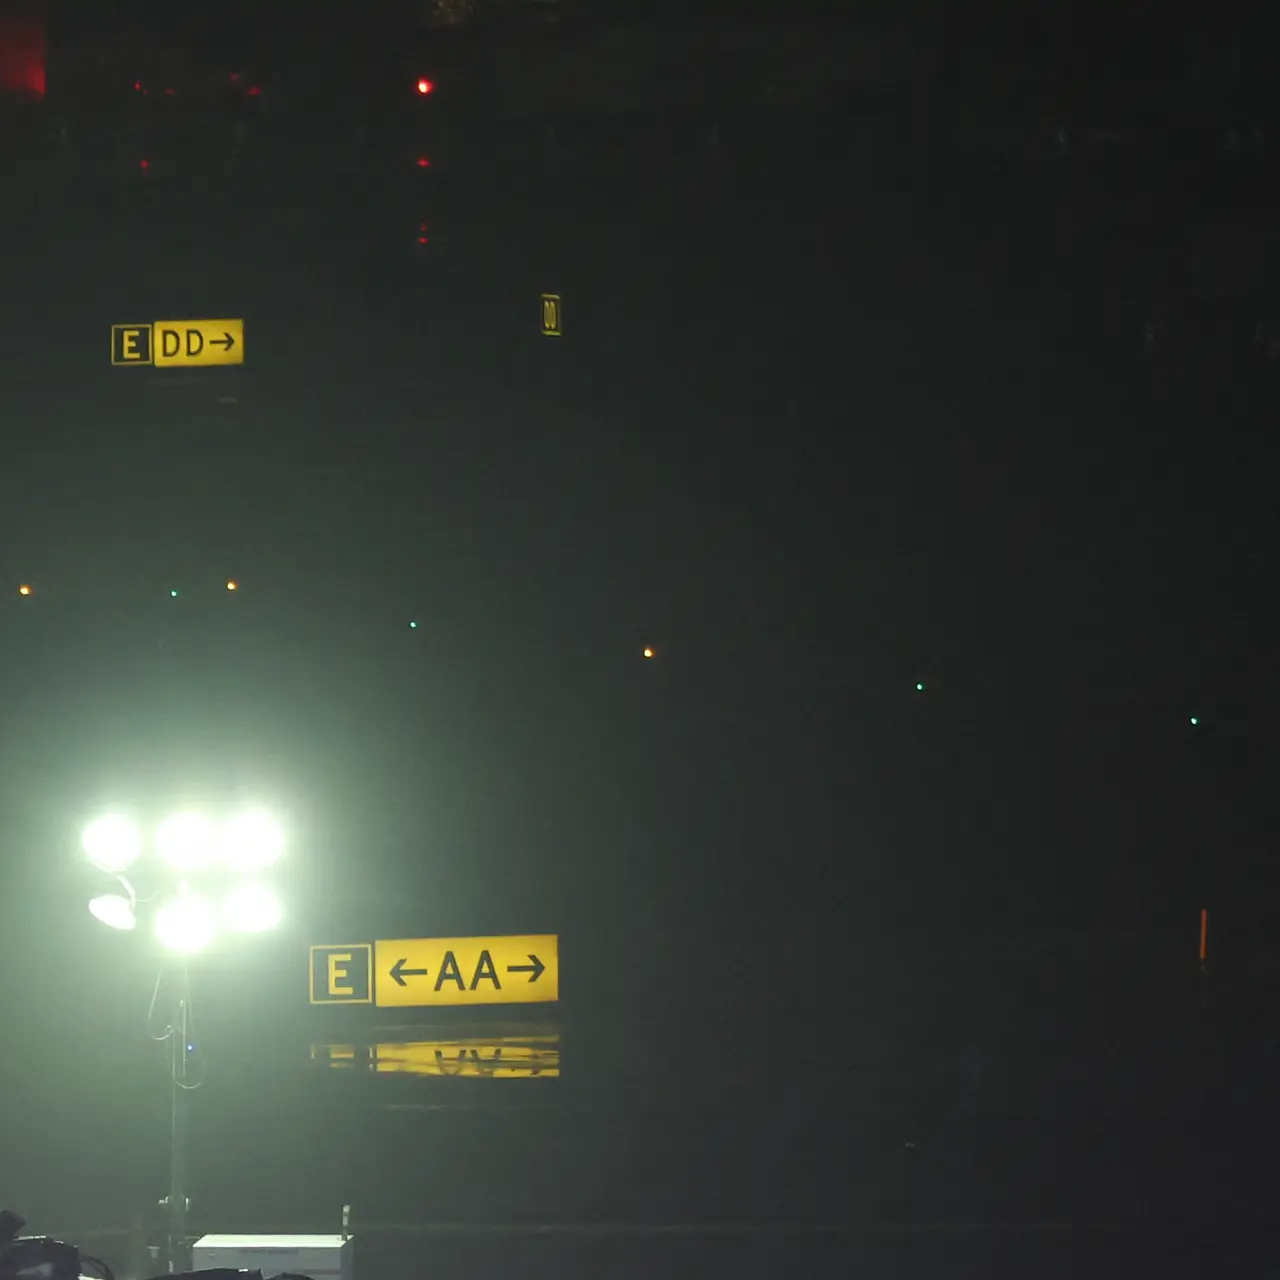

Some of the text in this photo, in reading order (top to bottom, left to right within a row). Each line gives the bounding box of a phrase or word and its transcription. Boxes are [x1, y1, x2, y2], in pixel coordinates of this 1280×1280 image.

[123, 329, 204, 359] E DD
[327, 950, 502, 995] E AA
